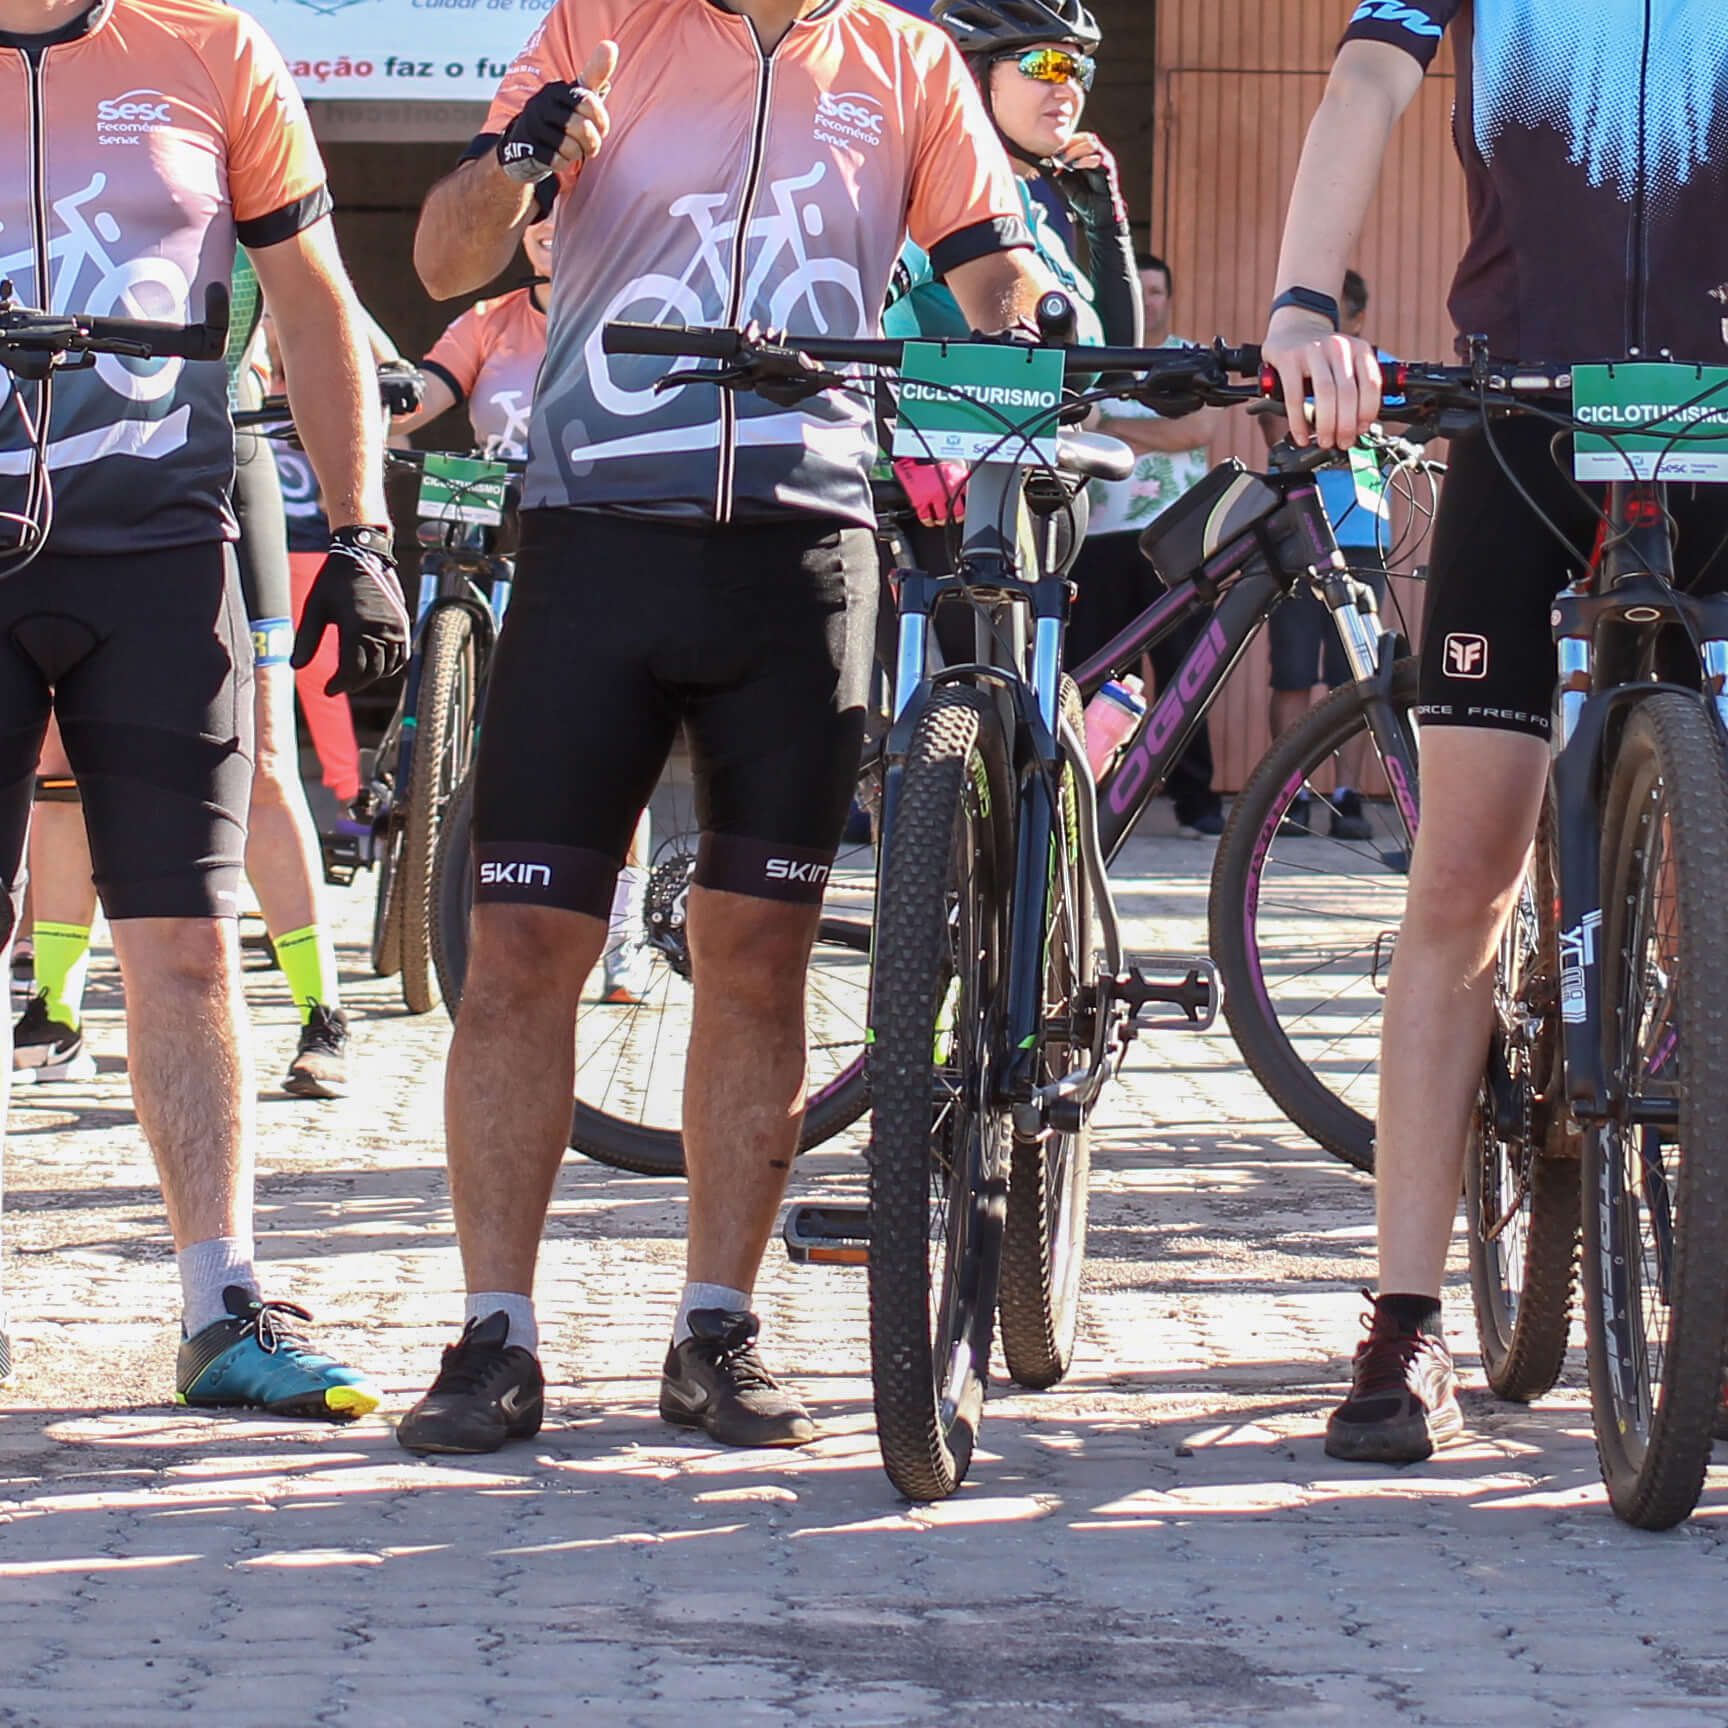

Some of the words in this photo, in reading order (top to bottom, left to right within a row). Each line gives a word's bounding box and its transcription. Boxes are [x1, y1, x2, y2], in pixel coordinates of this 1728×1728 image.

[384, 56, 435, 78] faz
[445, 60, 464, 78] o
[97, 92, 171, 121] Sesc
[817, 93, 884, 134] Sesc
[1467, 706, 1528, 722] FREE
